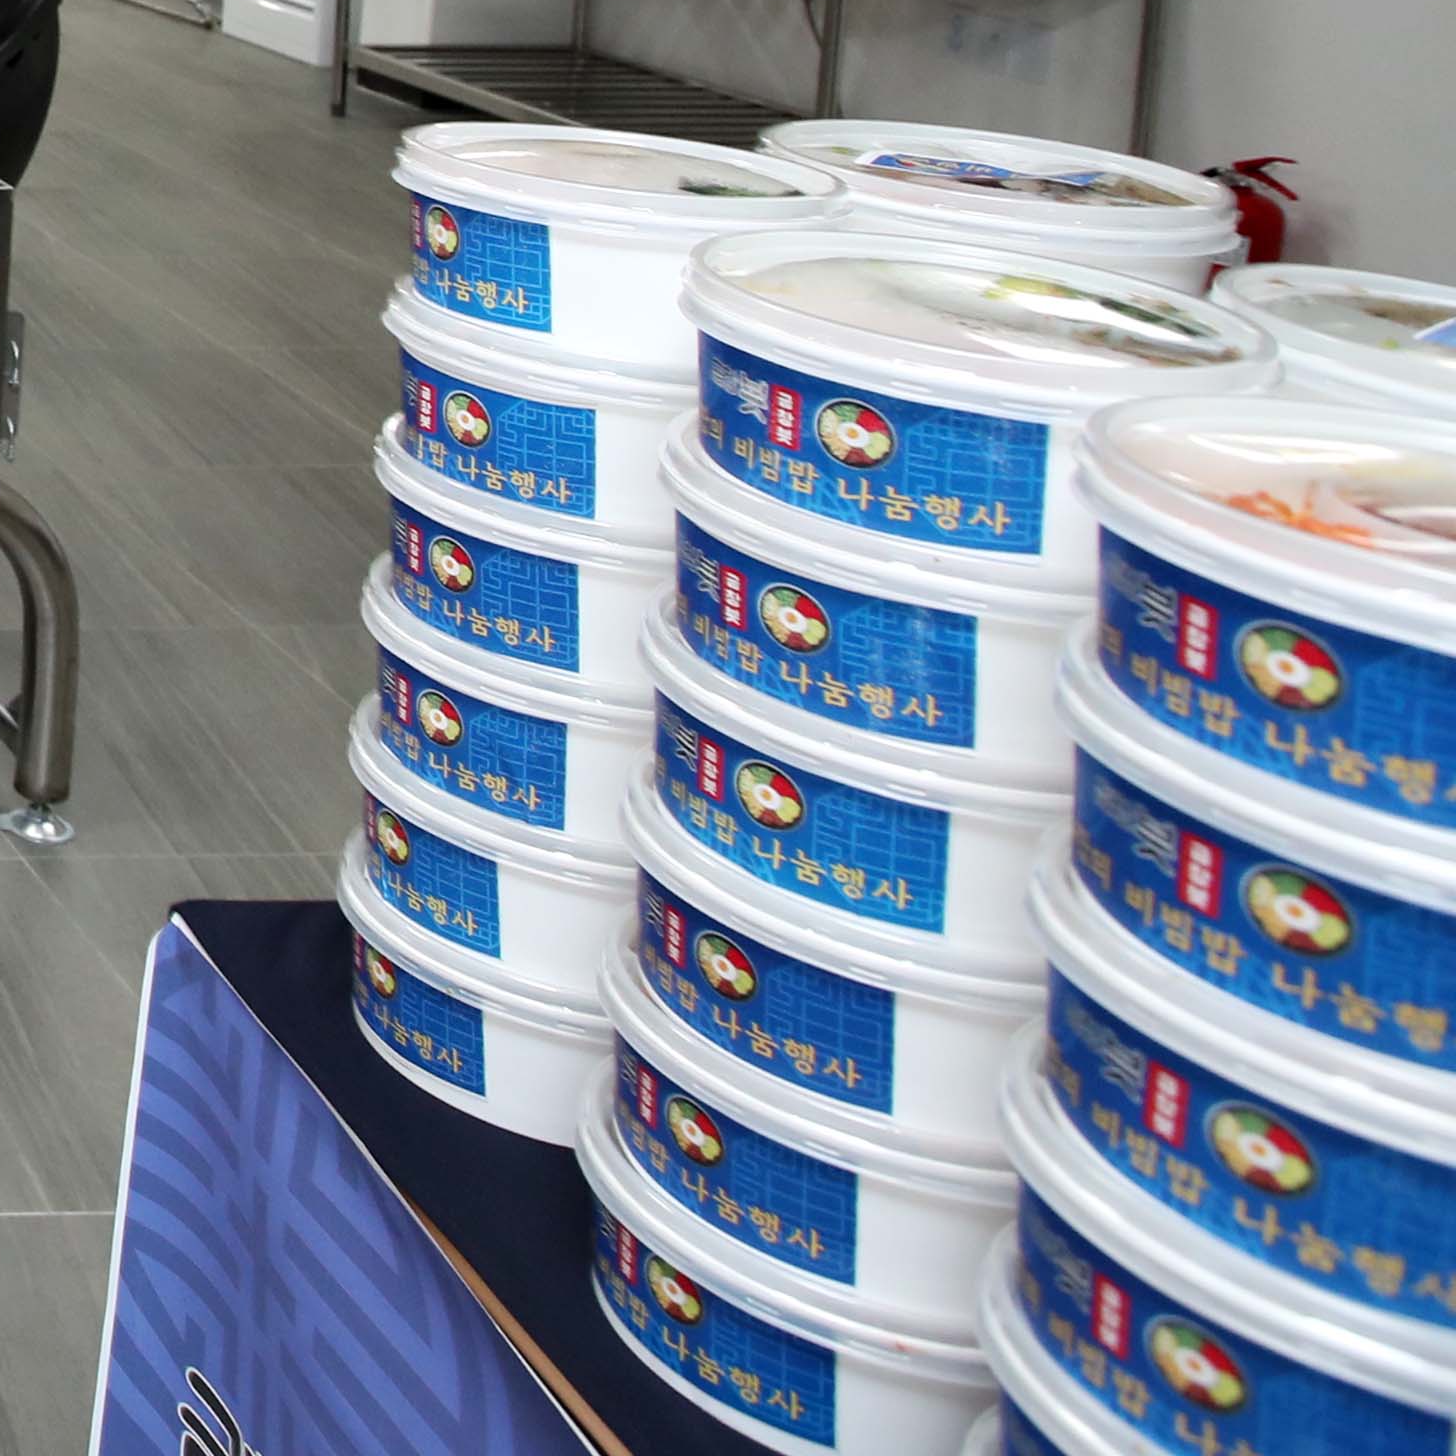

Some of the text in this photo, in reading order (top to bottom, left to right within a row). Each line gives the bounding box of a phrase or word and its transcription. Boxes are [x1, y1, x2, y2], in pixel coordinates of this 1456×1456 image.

[435, 268, 529, 314] 나눔행사
[458, 455, 572, 504] 나눔행사
[734, 437, 1011, 535] 비빔밥 나눔행사
[443, 599, 556, 652] 나눔행사
[694, 615, 943, 727] 비빔밥 나눔행사
[428, 752, 541, 811] 나눔행사
[1265, 720, 1456, 805] 나눔행
[387, 873, 479, 936] 나눔행사
[753, 836, 915, 910] 나눔행사
[374, 1003, 463, 1073] 나눔행사
[713, 1005, 863, 1088] 나눔행사
[682, 1168, 825, 1259] 나눔행사
[663, 1326, 806, 1421] 나눔행사
